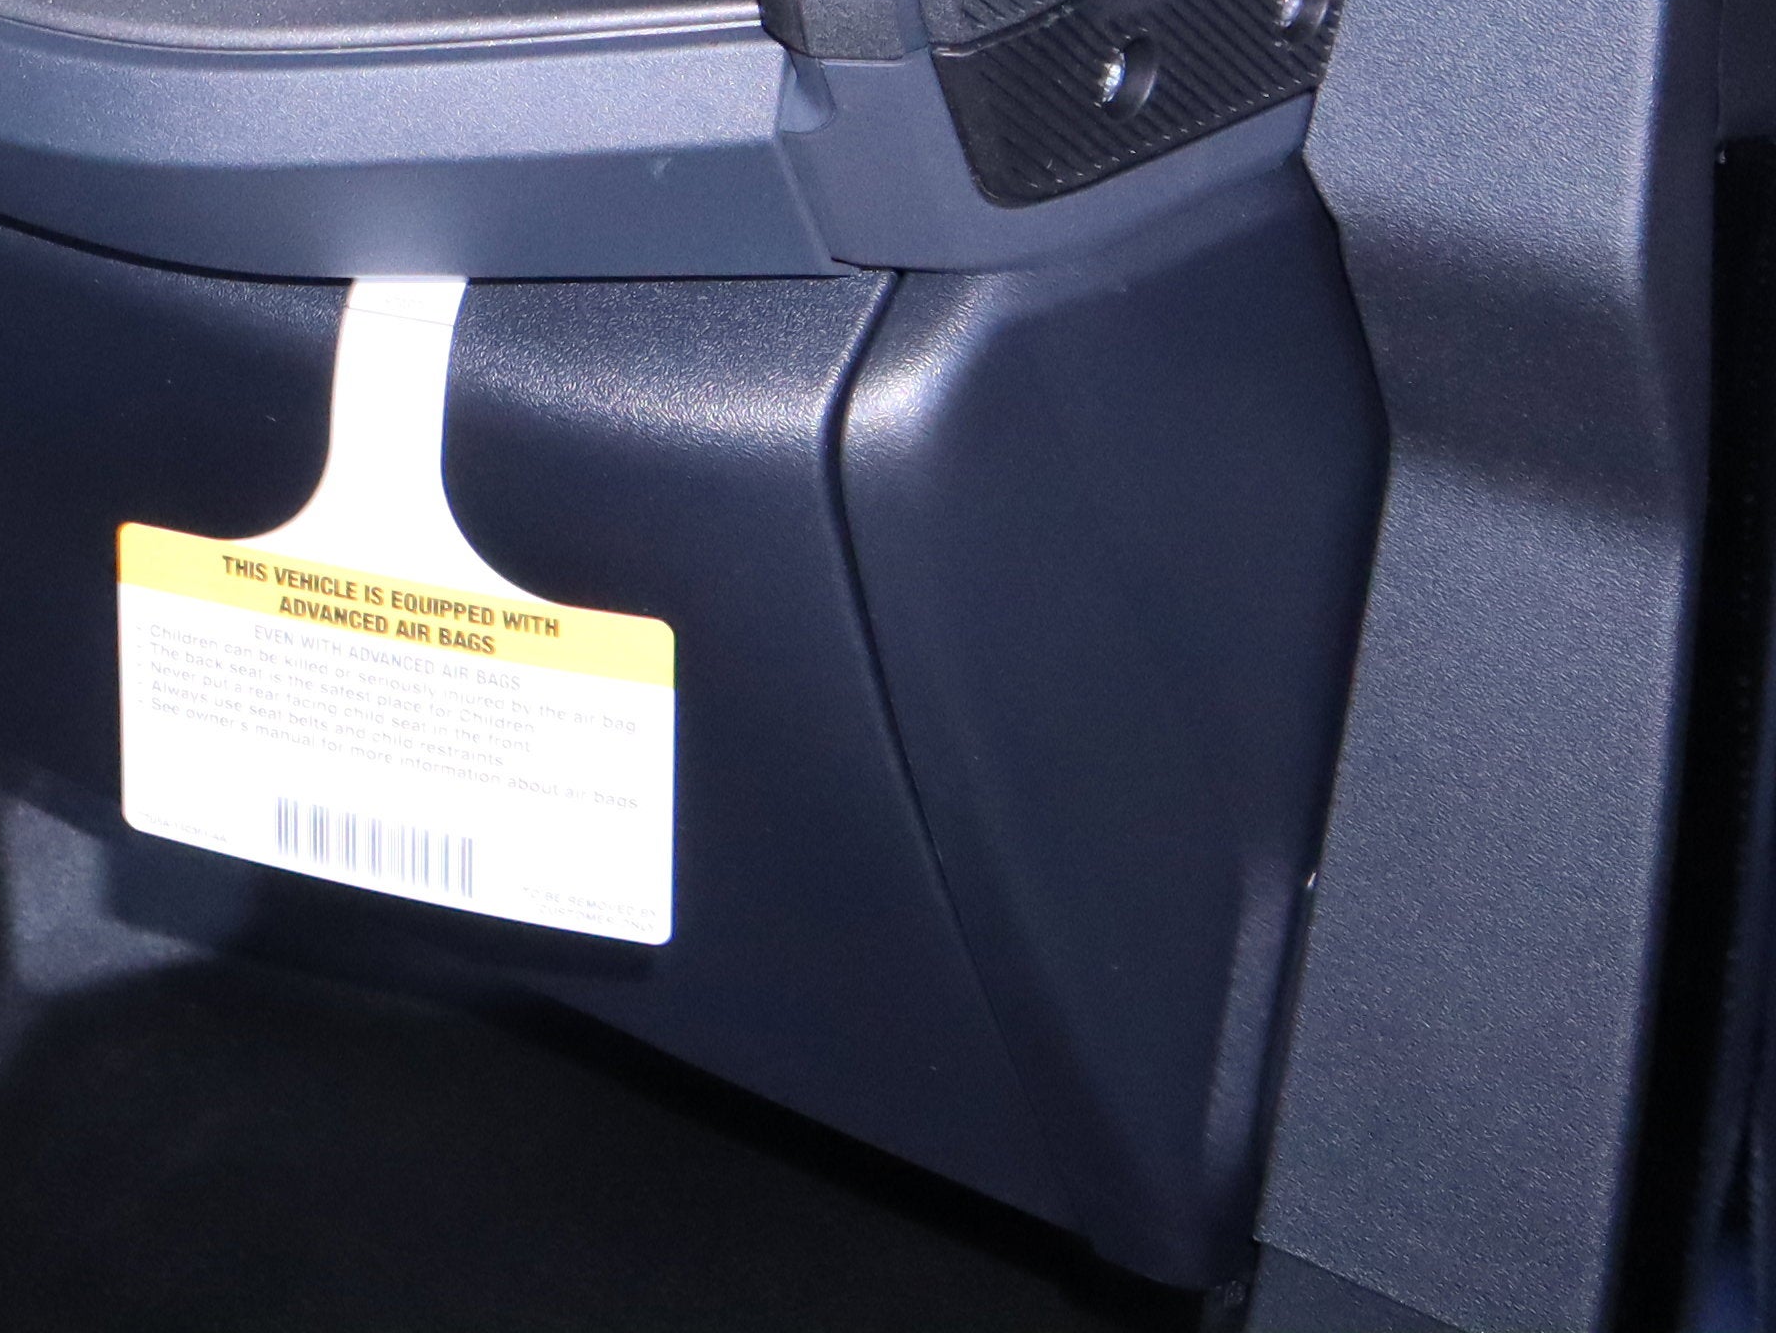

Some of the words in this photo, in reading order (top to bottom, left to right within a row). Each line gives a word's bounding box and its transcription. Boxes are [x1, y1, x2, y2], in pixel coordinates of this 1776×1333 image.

[222, 555, 269, 583] THIS
[274, 567, 359, 601] VEHICLE
[365, 585, 385, 606] IS
[391, 591, 495, 627] EQUIPPED
[502, 610, 561, 638] WITH
[279, 596, 389, 635] ADVANCED
[395, 621, 432, 644] AIR
[439, 628, 496, 655] BAGS
[150, 624, 218, 649] Children
[224, 643, 252, 658] can
[259, 649, 278, 665] be
[285, 655, 329, 675] killed
[335, 667, 351, 679] or
[359, 671, 436, 698] seriously
[443, 686, 505, 710] injured
[511, 700, 532, 716] by
[540, 705, 566, 721] the
[603, 715, 637, 734] bag
[150, 642, 180, 661] The
[185, 652, 223, 671] back
[230, 663, 263, 679] seat
[269, 671, 282, 684] is
[288, 675, 314, 691] the
[377, 694, 422, 714] place
[459, 709, 535, 734] Children
[254, 624, 293, 646] EVEN
[301, 634, 342, 656] WITH
[349, 647, 434, 675] ADVANCED
[442, 662, 469, 680] AIR
[476, 669, 521, 691] BAGS
[150, 661, 196, 681] Never
[234, 682, 243, 694] a
[248, 685, 279, 701] rear
[343, 705, 385, 726] child
[391, 715, 426, 734] seat
[455, 727, 481, 743] the
[151, 680, 209, 704] Always
[214, 696, 242, 711] use
[248, 705, 282, 721] seat
[289, 711, 329, 731] belts
[335, 723, 366, 740] and
[372, 731, 413, 749] child
[420, 741, 505, 767] restraints
[151, 697, 180, 715] See
[255, 724, 316, 748] manual
[350, 745, 393, 765] more
[399, 754, 501, 785] information
[507, 776, 560, 796] about
[593, 790, 639, 810] bags
